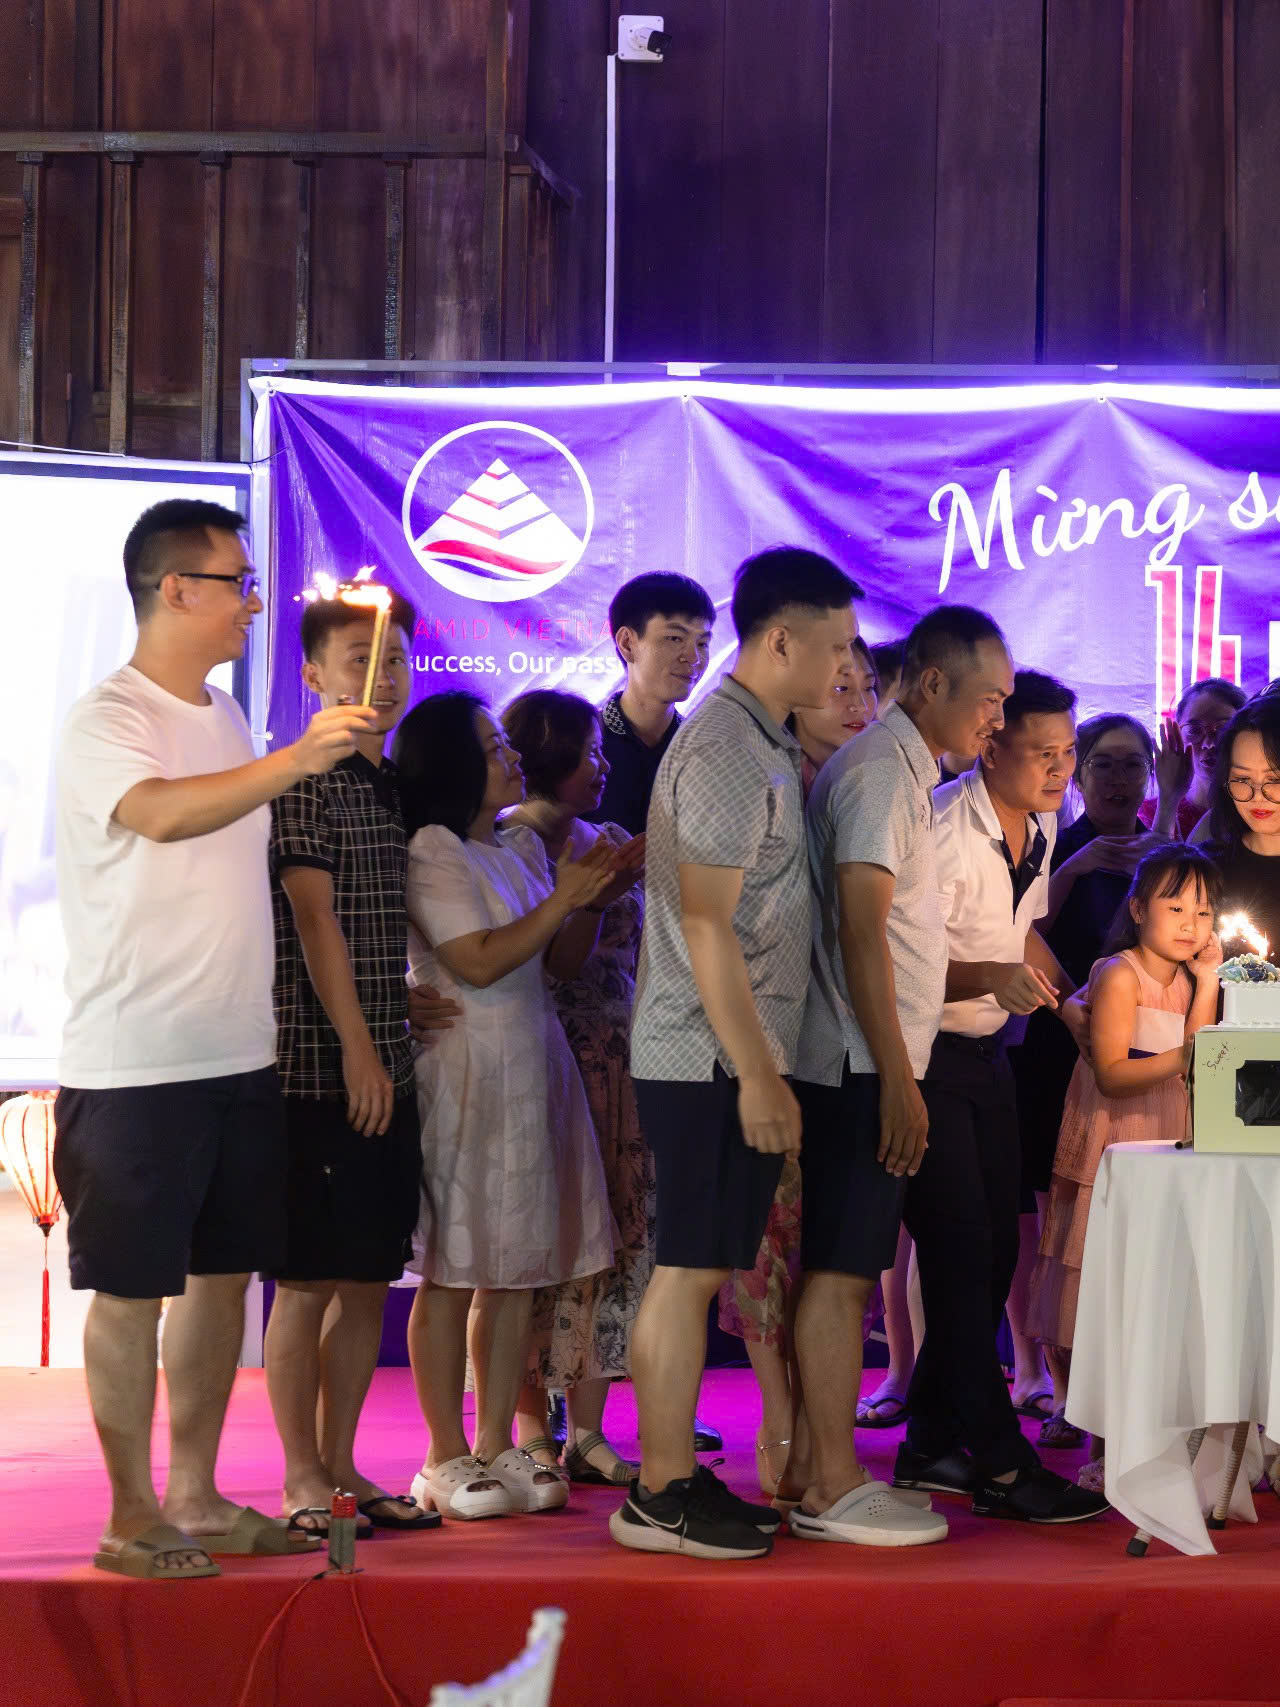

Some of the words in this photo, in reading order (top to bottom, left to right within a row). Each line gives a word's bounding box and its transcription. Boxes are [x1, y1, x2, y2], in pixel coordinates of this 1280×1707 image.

[928, 467, 1206, 595] Mừng
[414, 618, 490, 641] AMID
[503, 618, 613, 641] VIETNA
[508, 651, 555, 674] Our
